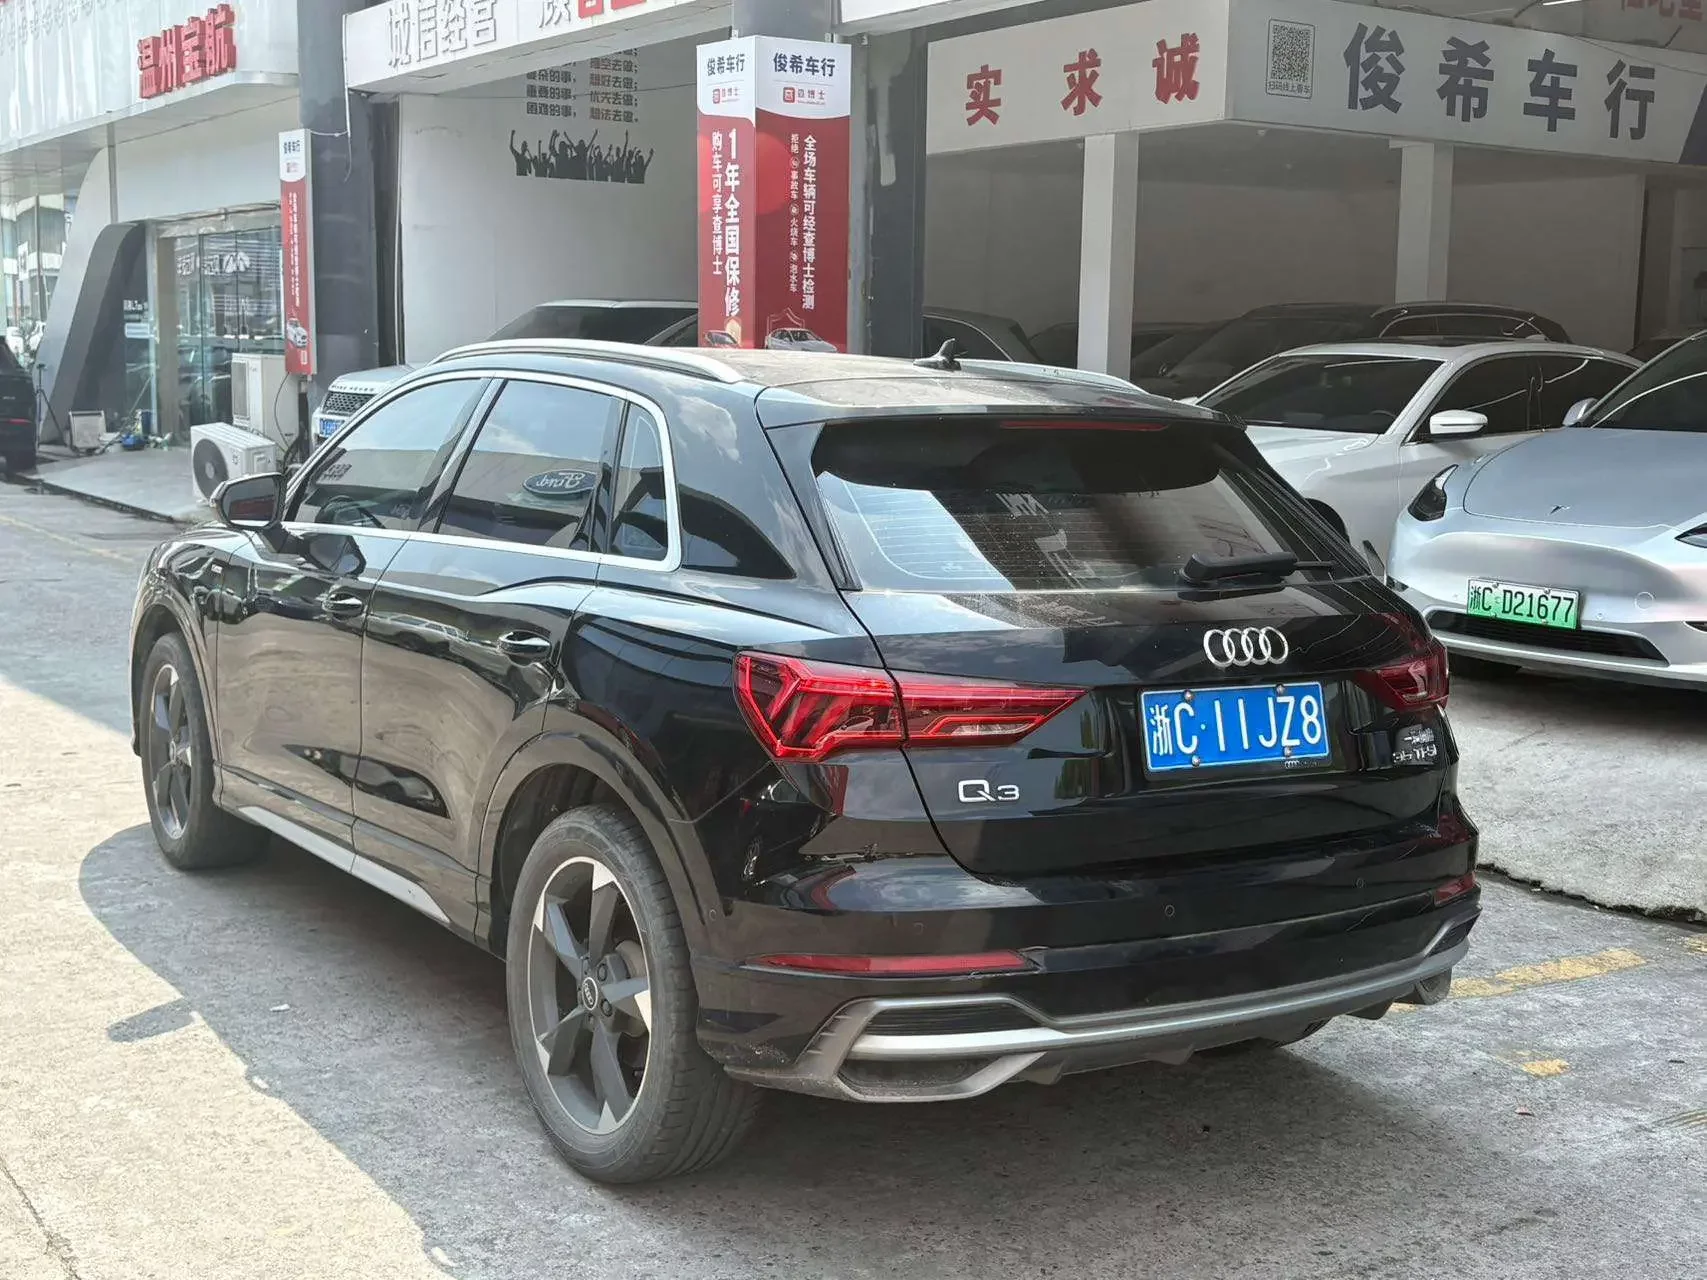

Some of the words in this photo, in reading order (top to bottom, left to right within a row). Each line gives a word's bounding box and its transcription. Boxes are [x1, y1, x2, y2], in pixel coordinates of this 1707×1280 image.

[707, 53, 745, 76] 俊希车行
[773, 53, 835, 77] 俊希车行
[1343, 22, 1655, 140] 俊希车行
[712, 131, 723, 275] 购车可享查博士
[725, 128, 740, 317] 1年全国保修
[803, 135, 816, 310] 全场车辆可经查博士检测
[958, 779, 1020, 802] Q3
